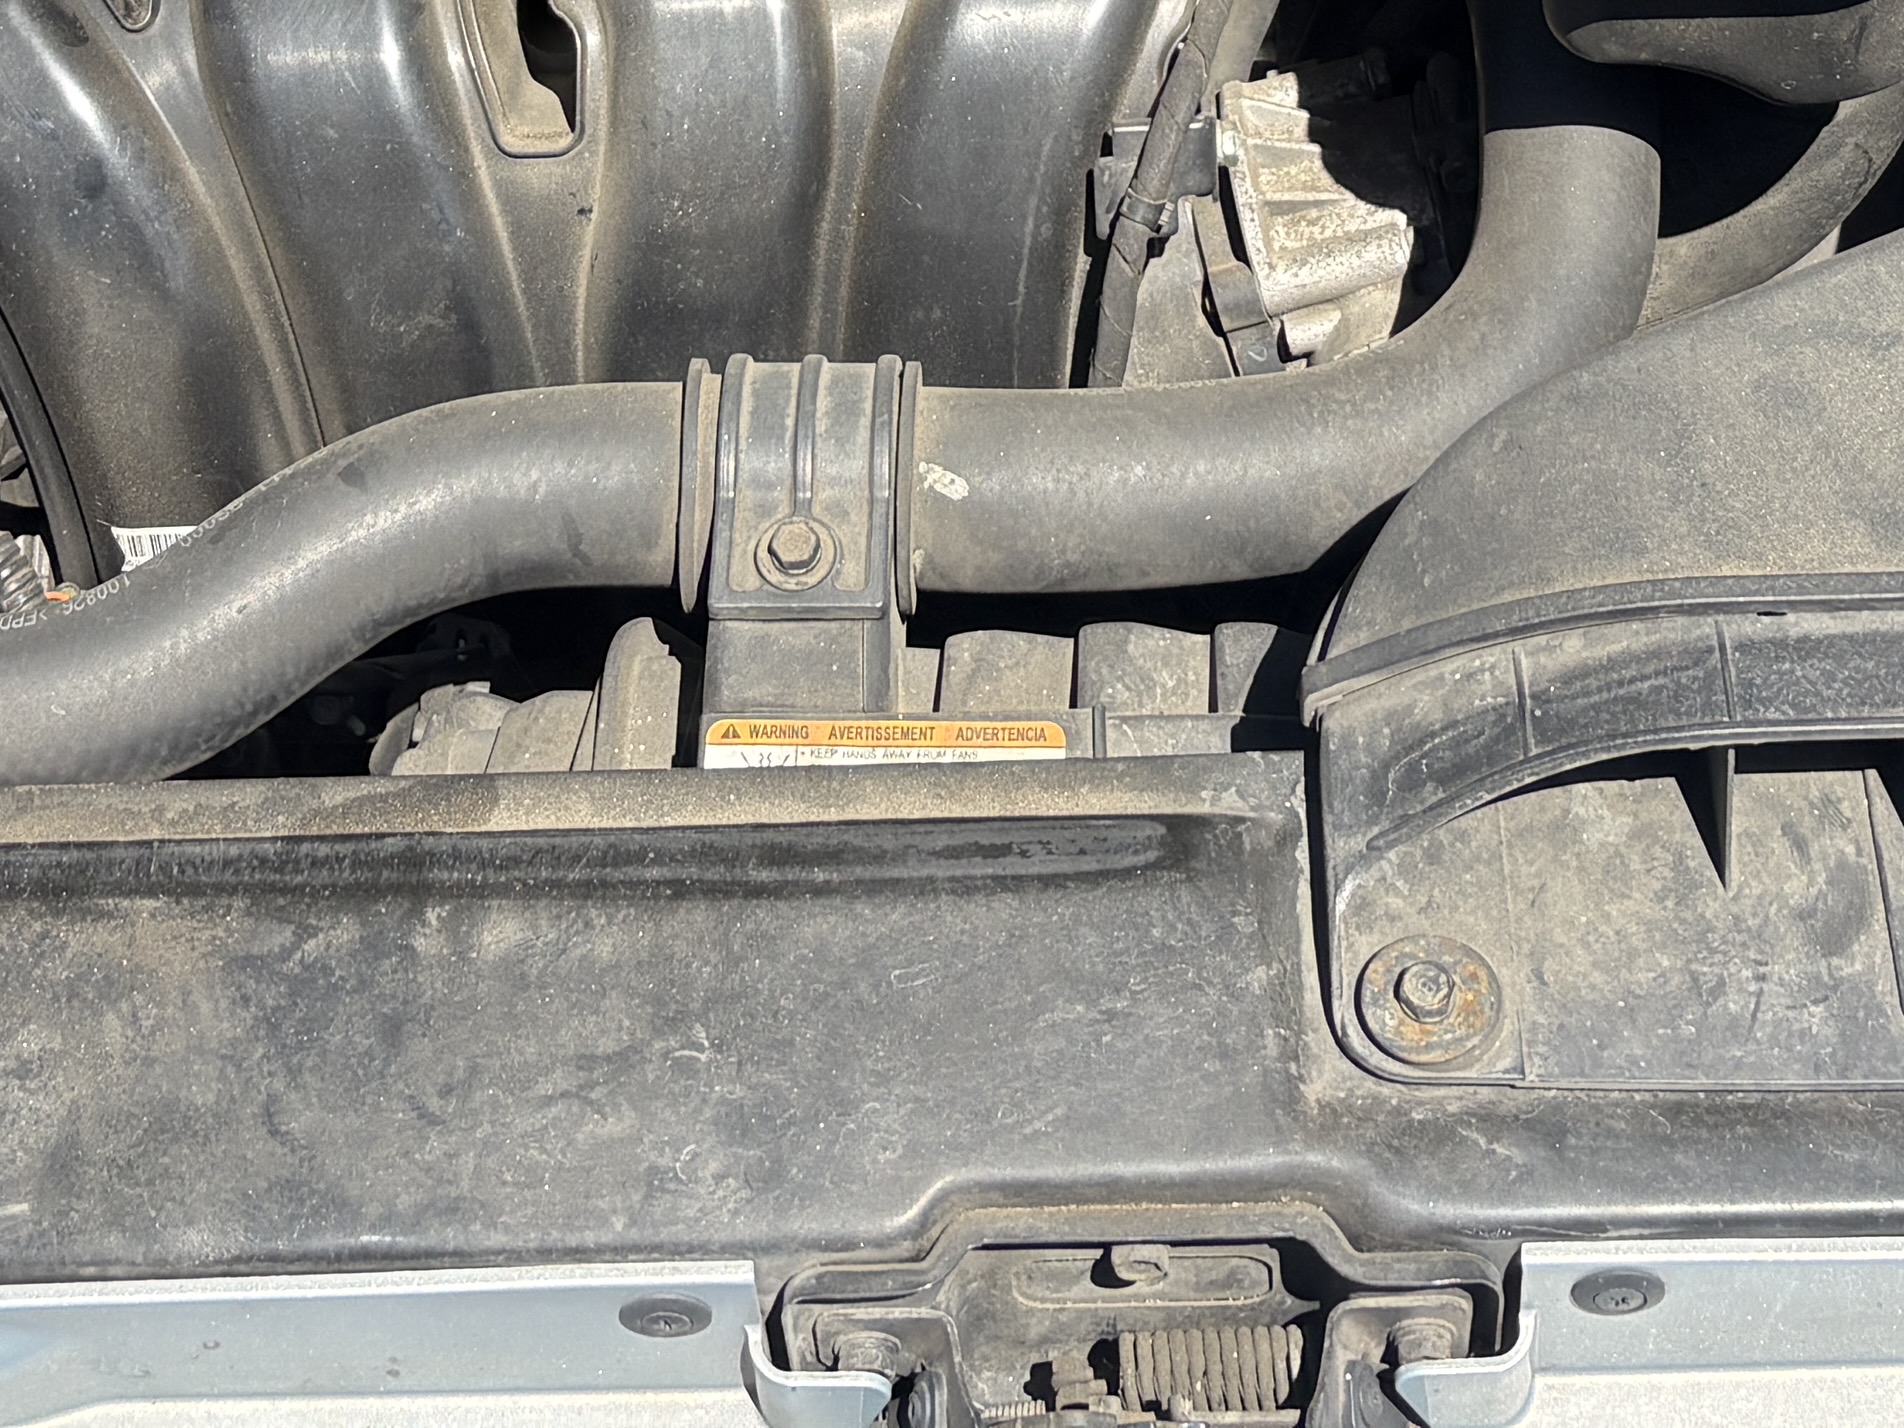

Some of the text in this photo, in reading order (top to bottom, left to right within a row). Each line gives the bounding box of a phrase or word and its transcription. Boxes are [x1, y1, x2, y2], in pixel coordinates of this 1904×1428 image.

[748, 723, 1048, 742] WARNING AVERTISSEMENT ADVERTENCIA
[810, 747, 836, 760] KEEP
[842, 747, 877, 760] HANDS
[882, 747, 911, 760] AWAY
[952, 749, 978, 761] FANS
